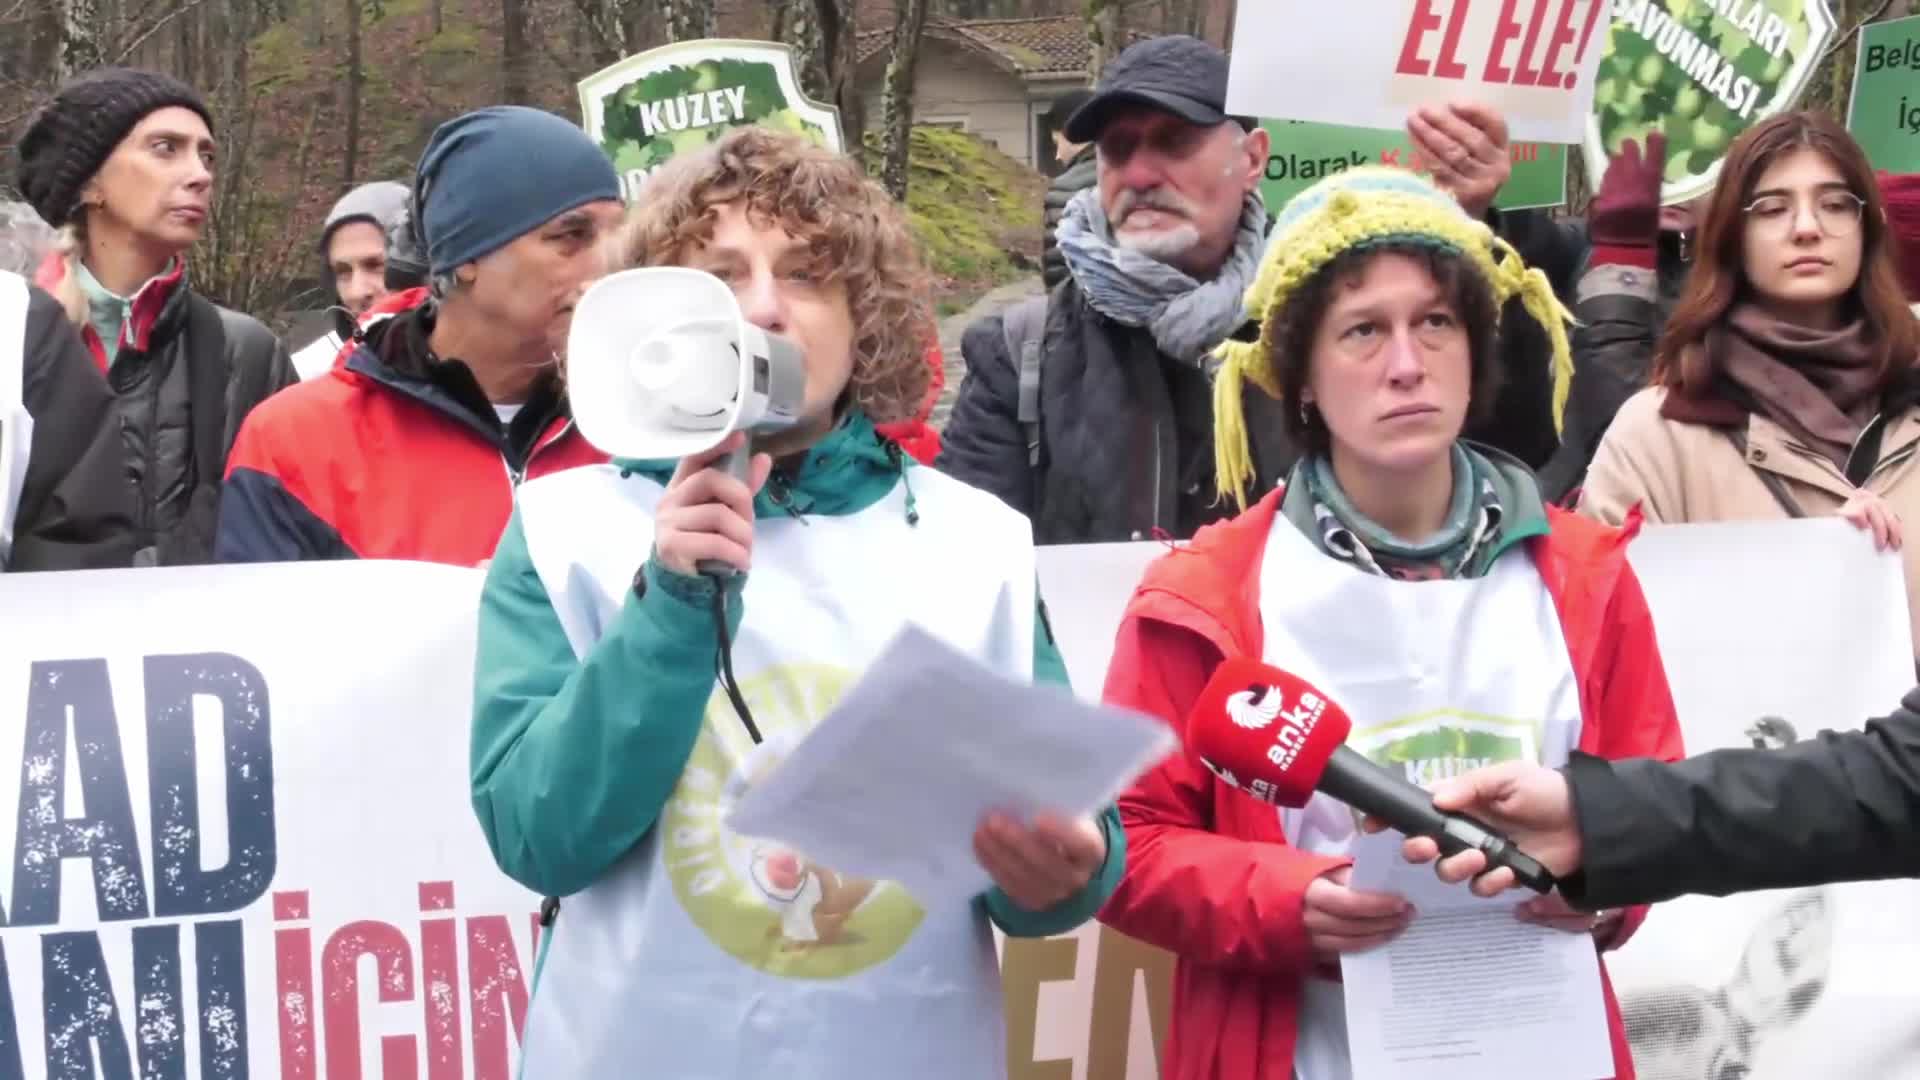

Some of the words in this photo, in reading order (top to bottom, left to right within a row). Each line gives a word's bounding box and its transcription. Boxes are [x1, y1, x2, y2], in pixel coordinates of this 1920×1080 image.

[1396, 0, 1467, 79] EL
[1482, 0, 1602, 90] ELE!
[639, 85, 746, 137] KUZEY
[1264, 150, 1369, 181] Olarak
[1267, 691, 1321, 765] anka
[0, 651, 278, 927] AD
[0, 918, 250, 1080] NI
